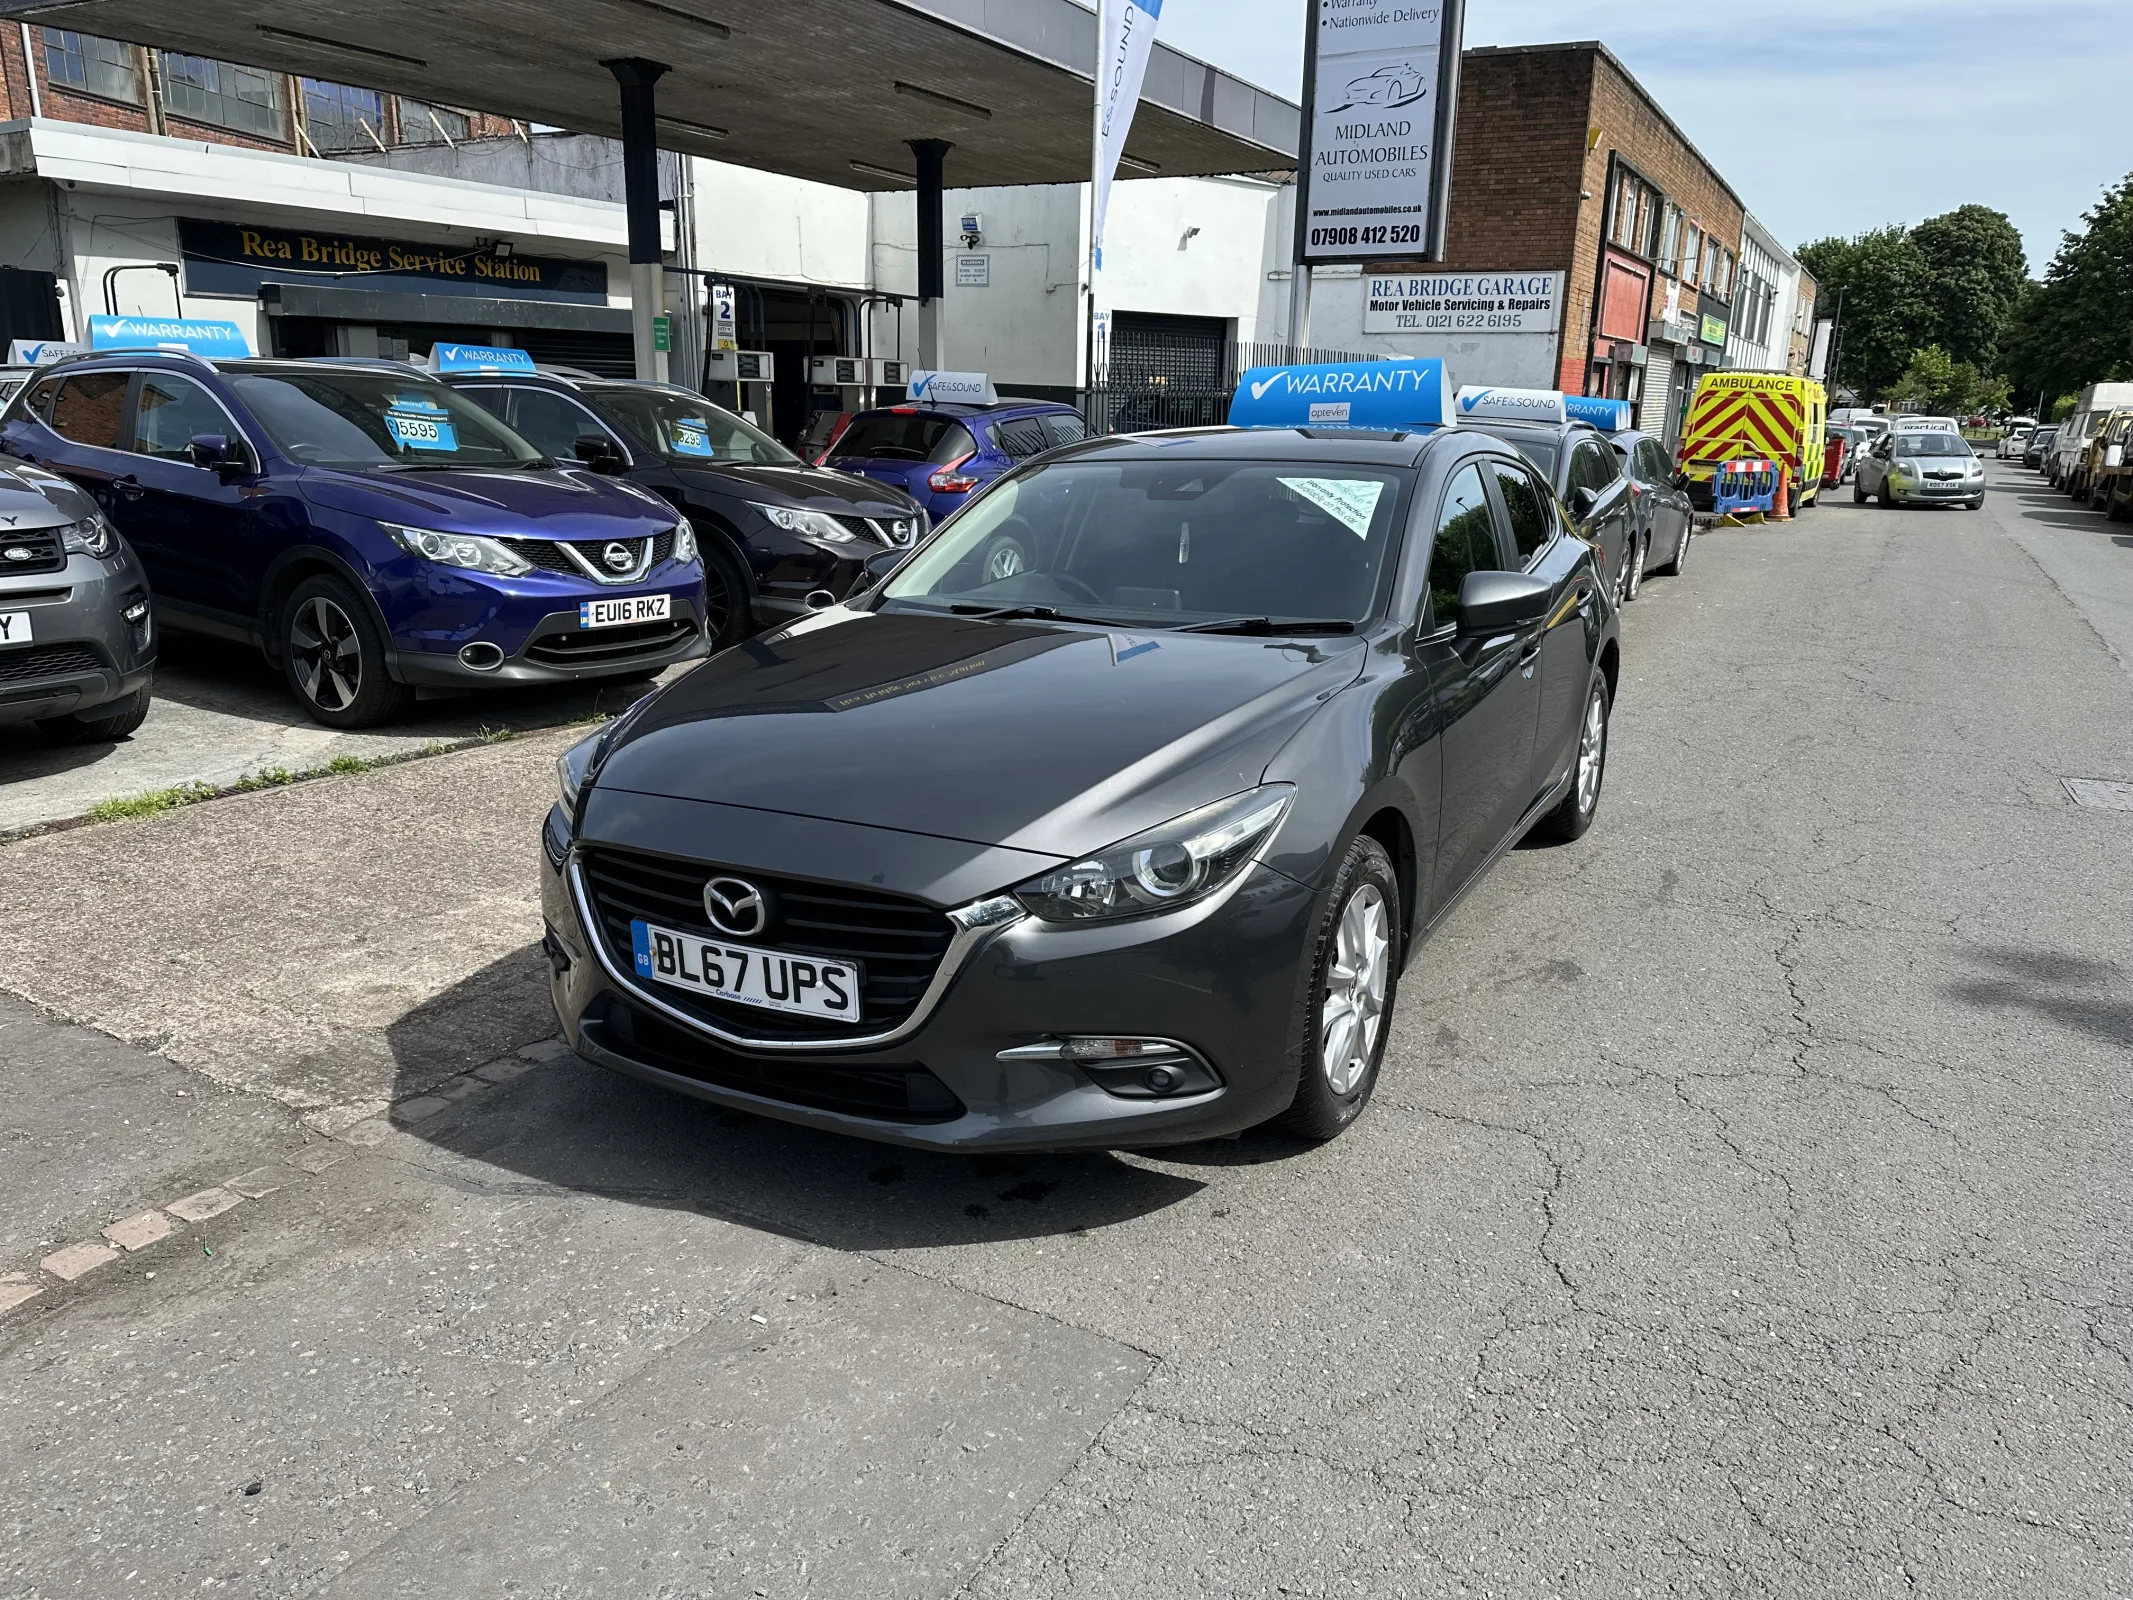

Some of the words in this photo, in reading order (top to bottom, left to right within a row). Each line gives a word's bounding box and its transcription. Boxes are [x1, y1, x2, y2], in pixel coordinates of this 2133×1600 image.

[1331, 0, 1378, 9] Warranty
[1330, 11, 1390, 29] Nationwide
[1394, 8, 1440, 23] Delivery
[1102, 5, 1134, 137] E&SOUND
[1335, 120, 1411, 140] MIDLAND
[1315, 145, 1428, 165] AUTOMOBILES
[1323, 170, 1362, 182] QUALITY
[1364, 169, 1389, 179] USED
[1392, 168, 1416, 178] CARS
[1313, 204, 1422, 217] www.midlandautomobiles.co.uk
[1311, 227, 1358, 246] 07908
[1361, 225, 1387, 244] 412
[1390, 224, 1420, 243] 520
[240, 230, 293, 260] Rea
[299, 237, 382, 272] Bridge
[388, 246, 466, 275] Service
[475, 255, 542, 282] Station
[716, 289, 732, 299] BAY
[1371, 280, 1405, 297] REA
[1408, 278, 1473, 296] BRIDGE
[1477, 277, 1552, 296] GARAGE
[720, 300, 731, 319] 2
[1369, 300, 1400, 312] Motor
[1402, 299, 1441, 311] Vehicle
[1444, 298, 1495, 312] Servicing
[1497, 300, 1505, 310] &
[1508, 298, 1550, 311] Repairs
[1093, 312, 1110, 321] BAY
[1396, 315, 1423, 327] TEL.
[1426, 314, 1452, 327] 0121
[1456, 314, 1484, 327] 622
[1487, 314, 1522, 327] 6195
[129, 321, 232, 341] WARRANTY
[460, 348, 525, 364] WARRANTY
[928, 381, 981, 393] SAFE&SOUND
[1287, 368, 1430, 395] WARRANTY
[1709, 378, 1794, 391] AMBULANCE
[1482, 395, 1556, 409] SAFE&SOUND
[1311, 405, 1349, 418] opteven
[1567, 403, 1612, 417] RRANTY
[1295, 483, 1325, 503] Available
[1323, 501, 1334, 509] on
[1332, 506, 1344, 517] this
[1343, 515, 1358, 524] car
[1306, 479, 1335, 498] Warranty
[1334, 497, 1367, 520] Protection
[595, 602, 632, 623] EU16
[637, 598, 665, 618] RKZ
[580, 616, 589, 624] UK
[637, 953, 649, 965] GB
[654, 932, 749, 992] BL67
[762, 956, 849, 1011] UPS
[715, 988, 742, 1001] Carbase
